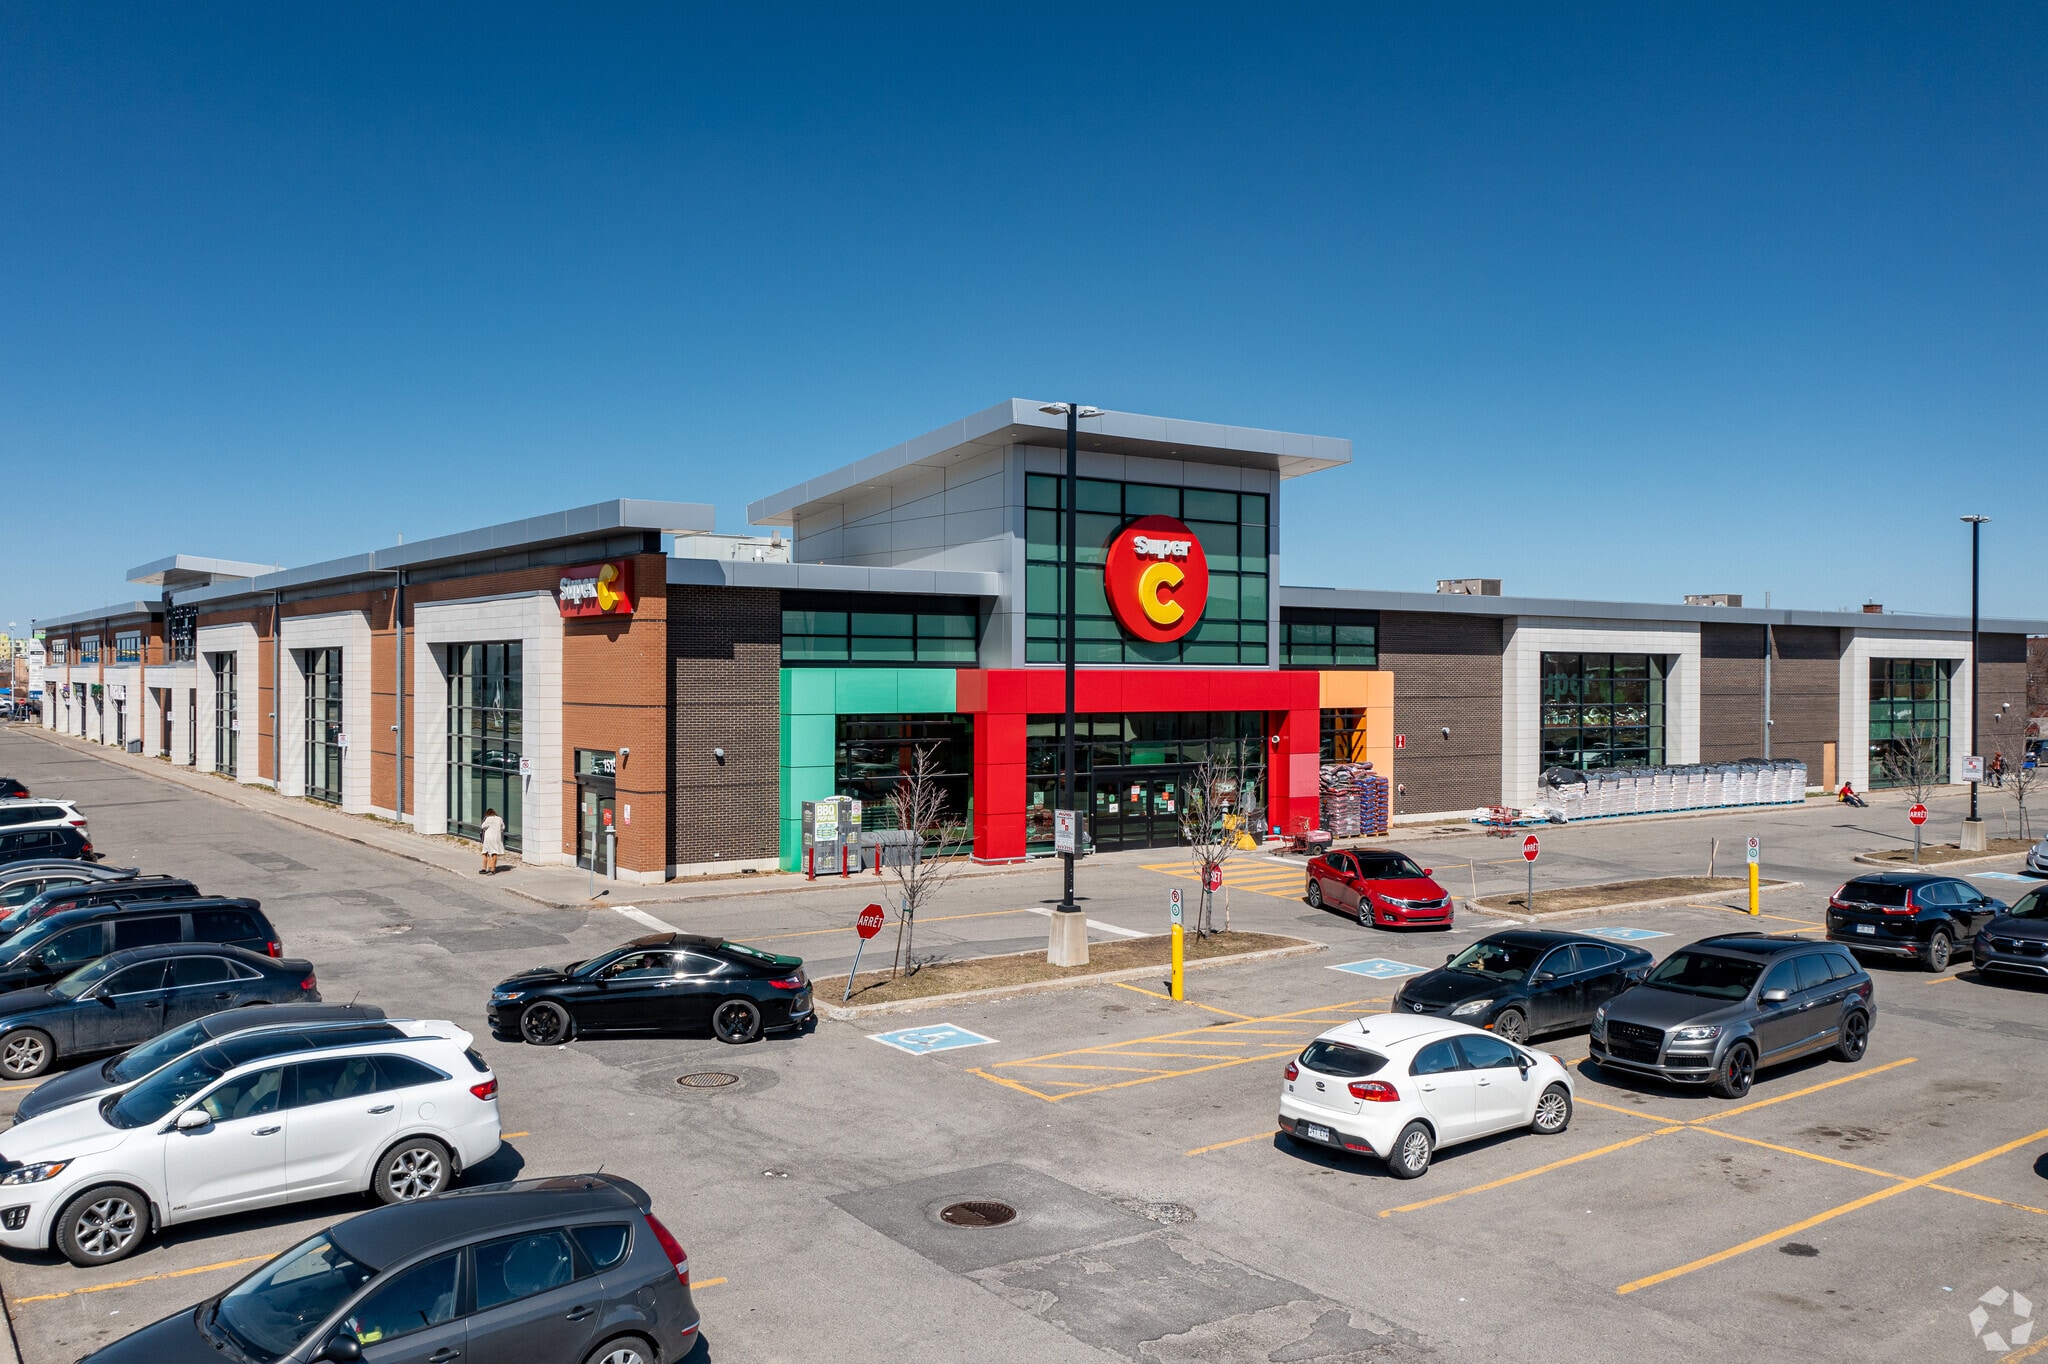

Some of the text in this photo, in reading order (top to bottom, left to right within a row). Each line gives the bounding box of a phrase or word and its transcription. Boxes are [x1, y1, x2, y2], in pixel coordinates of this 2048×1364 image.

[1133, 535, 1192, 559] Super
[560, 563, 620, 611] Super C
[1139, 561, 1185, 625] C
[1545, 672, 1595, 702] uper
[816, 804, 836, 816] BBQ
[1909, 810, 1927, 819] ARRÊT
[1524, 842, 1539, 852] ARRÊT
[857, 914, 884, 929] ARRÊT
